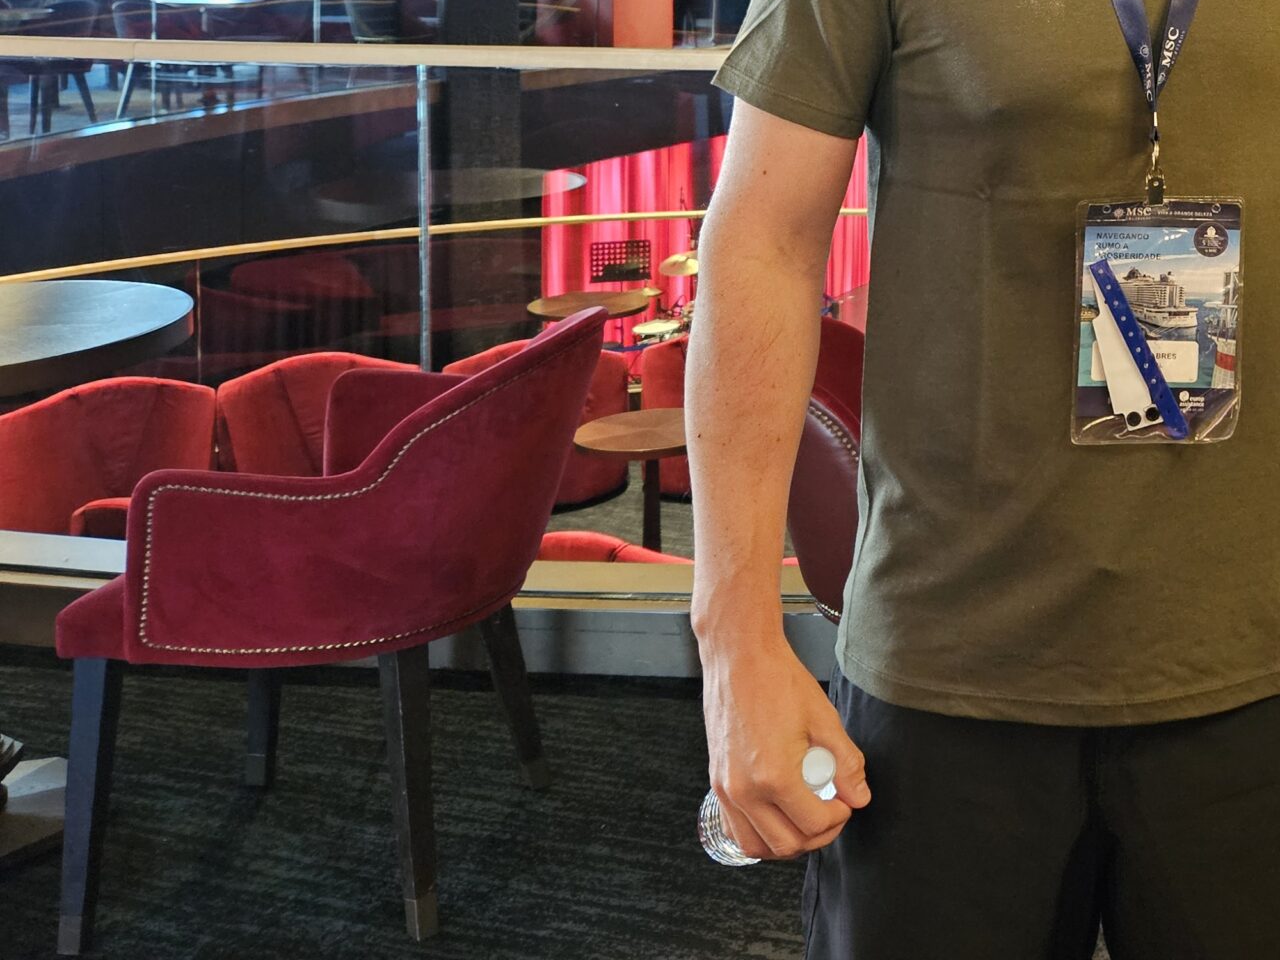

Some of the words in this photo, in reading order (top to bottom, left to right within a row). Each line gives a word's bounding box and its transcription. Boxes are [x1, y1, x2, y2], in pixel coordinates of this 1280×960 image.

[1161, 26, 1180, 68] MSC
[1126, 207, 1152, 216] MSC
[1096, 232, 1150, 240] NAVEGANDO
[1155, 352, 1177, 360] BRES
